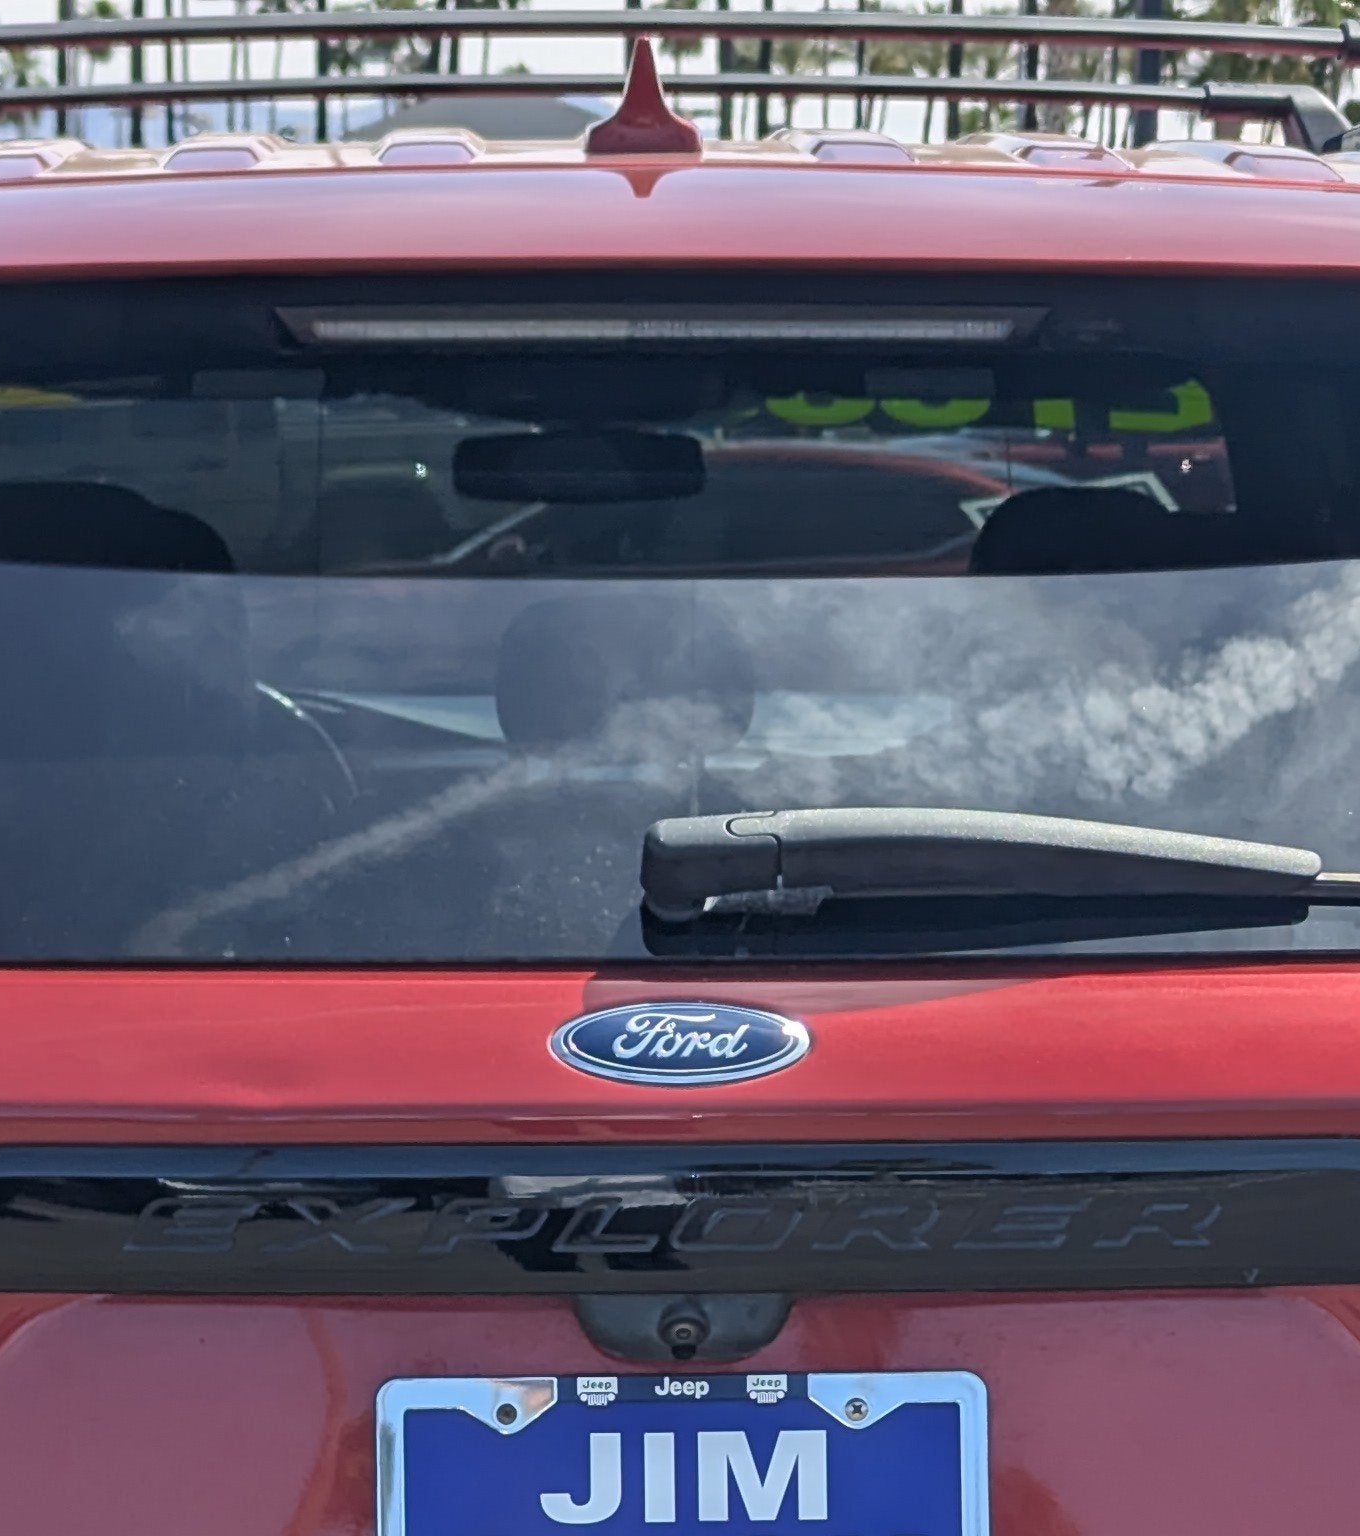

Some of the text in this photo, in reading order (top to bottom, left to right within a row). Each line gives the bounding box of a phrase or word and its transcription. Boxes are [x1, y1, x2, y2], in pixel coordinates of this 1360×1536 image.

[612, 1013, 750, 1059] Ford
[122, 1195, 1223, 1252] EXPLORER
[582, 1380, 612, 1390] Jeep
[654, 1376, 710, 1399] Jeep
[752, 1377, 782, 1388] Jeep
[540, 1430, 828, 1524] JIM
